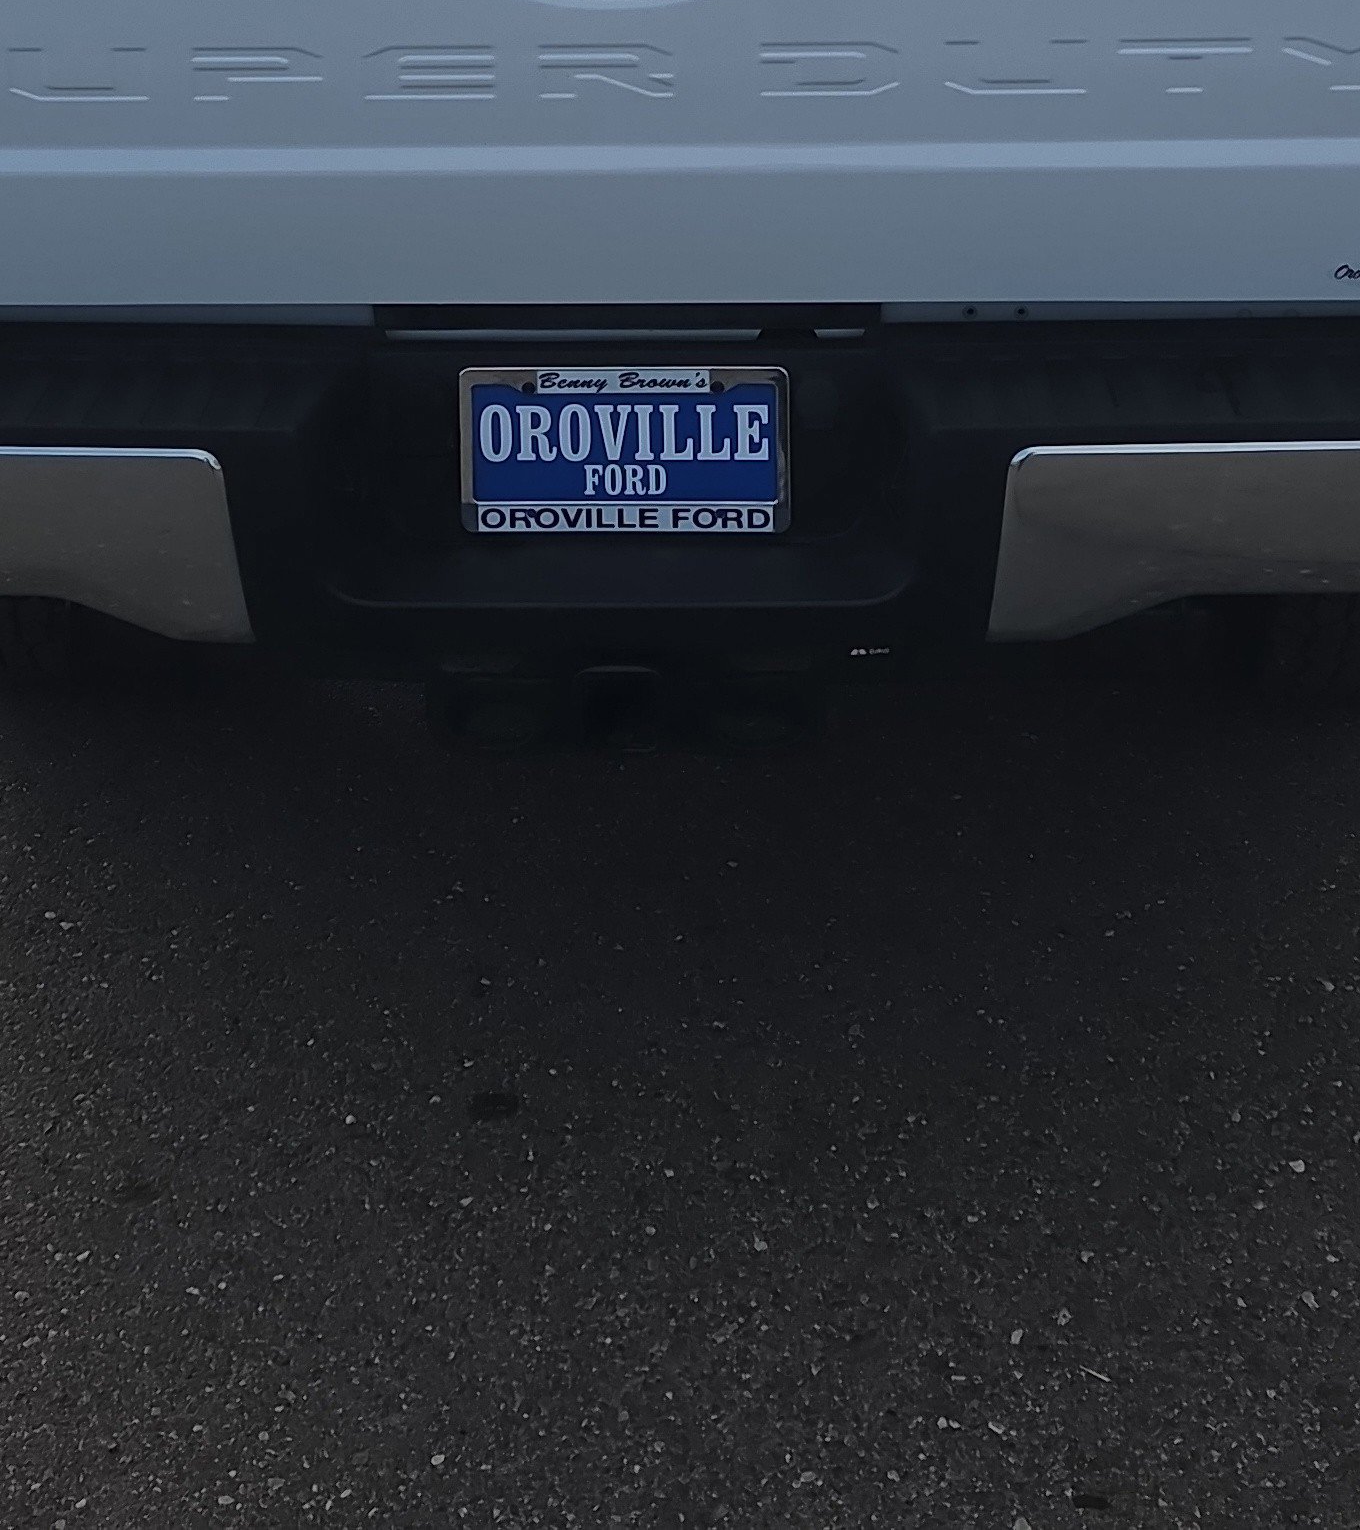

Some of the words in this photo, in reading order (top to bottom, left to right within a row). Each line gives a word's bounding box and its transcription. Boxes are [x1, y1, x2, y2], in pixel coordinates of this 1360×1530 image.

[538, 372, 608, 393] Benny
[618, 372, 709, 392] Brown's
[479, 404, 770, 462] OROVILLE
[583, 464, 667, 496] FORD
[480, 508, 659, 530] OROVILLE
[672, 508, 771, 530] FORD
